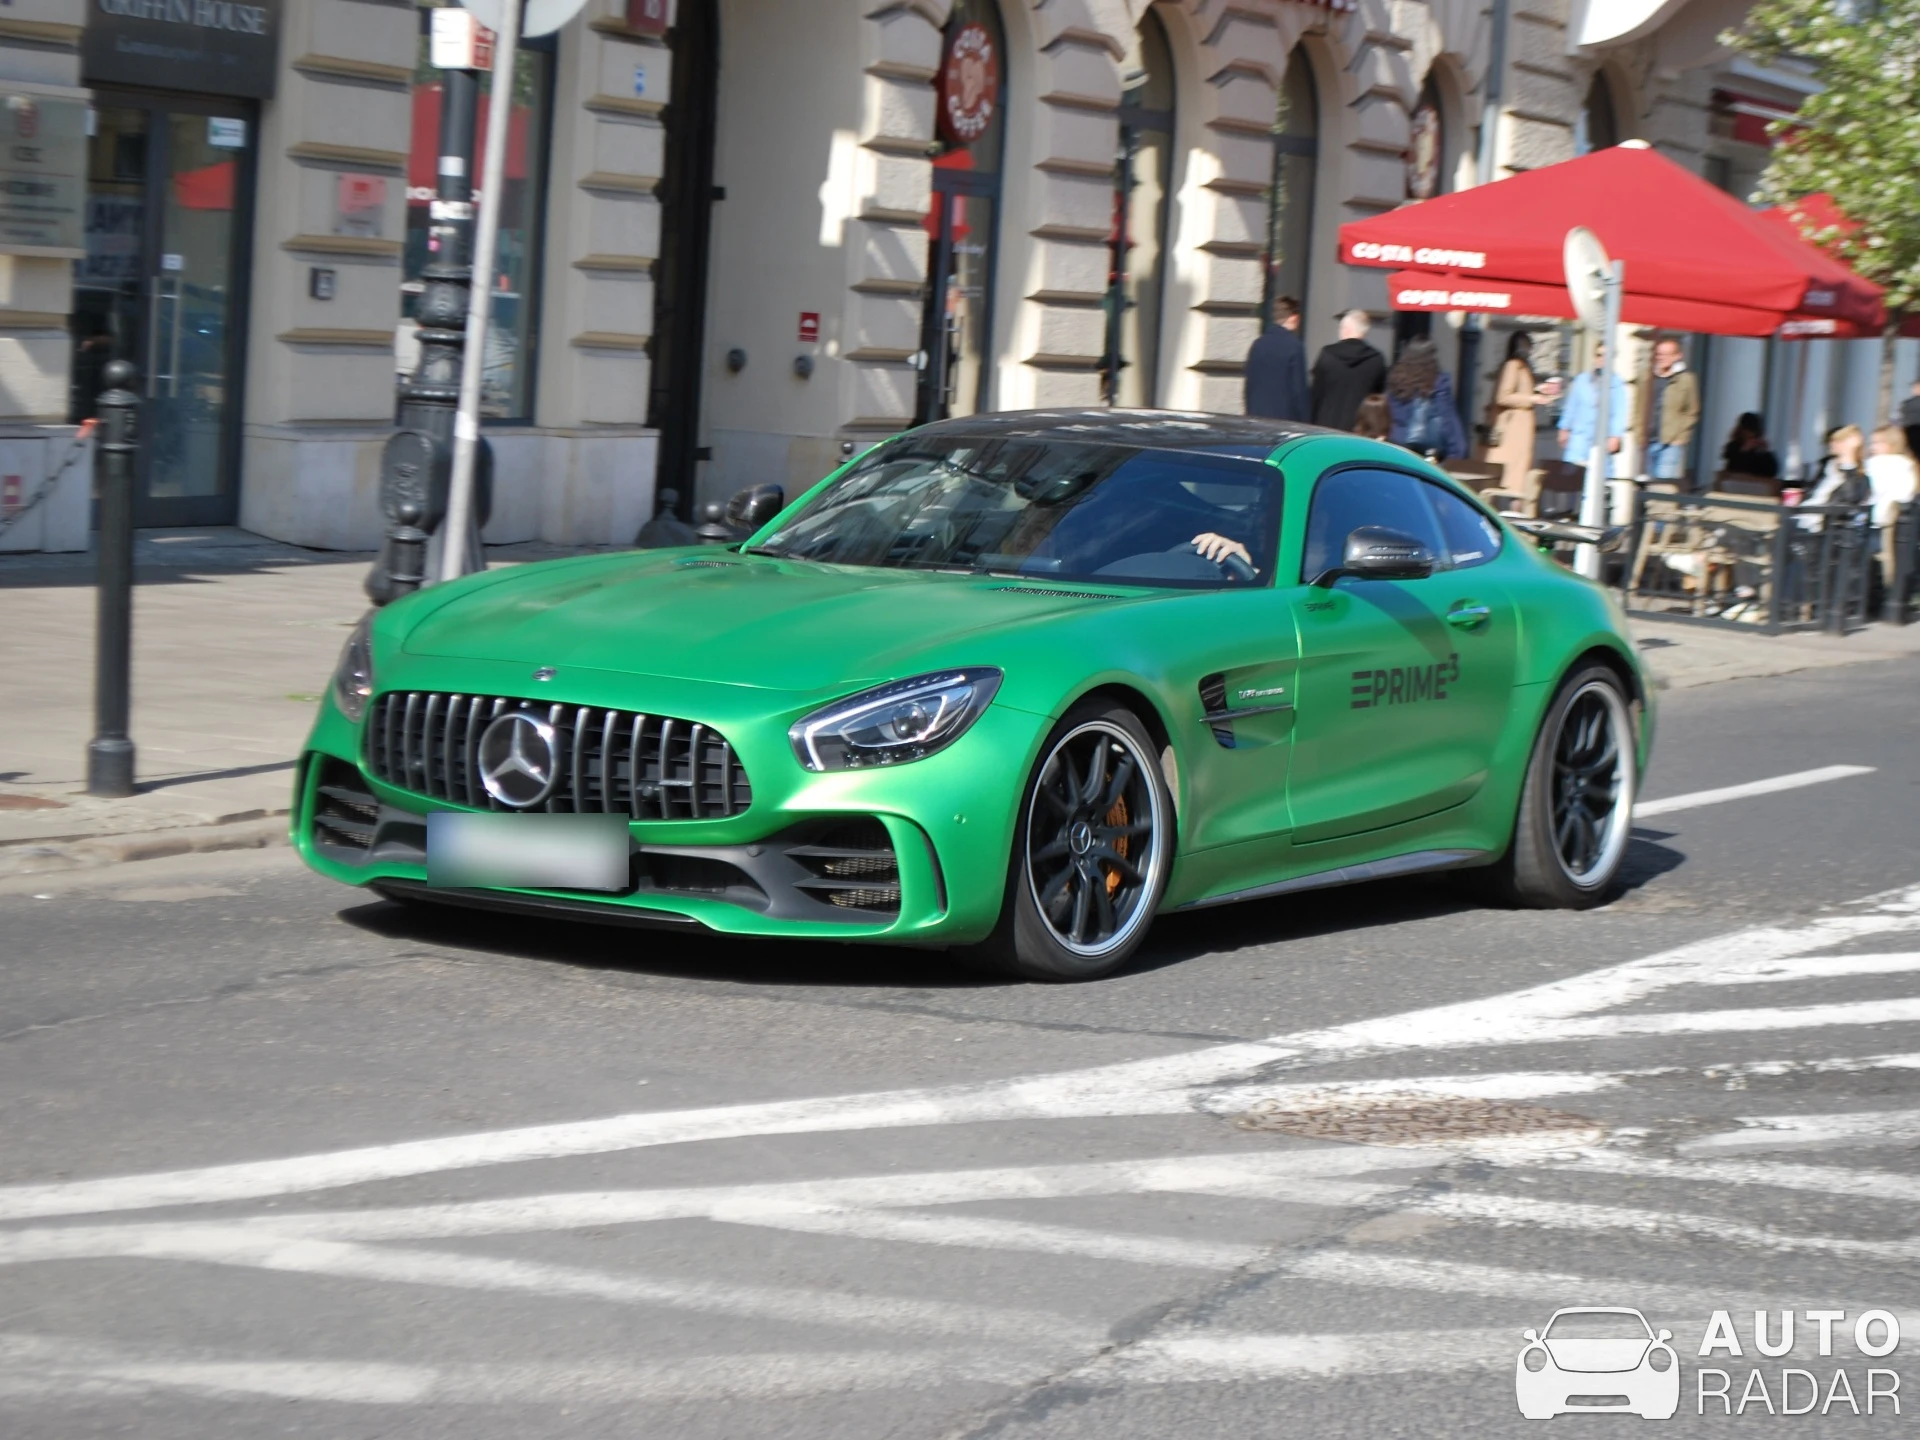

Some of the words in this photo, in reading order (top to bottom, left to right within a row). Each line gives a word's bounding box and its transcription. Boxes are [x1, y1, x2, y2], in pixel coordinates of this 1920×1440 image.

[192, 0, 267, 36] HOUSE
[1351, 242, 1413, 262] COSTA
[1414, 248, 1486, 268] COFFEE
[1396, 289, 1449, 306] COSTA
